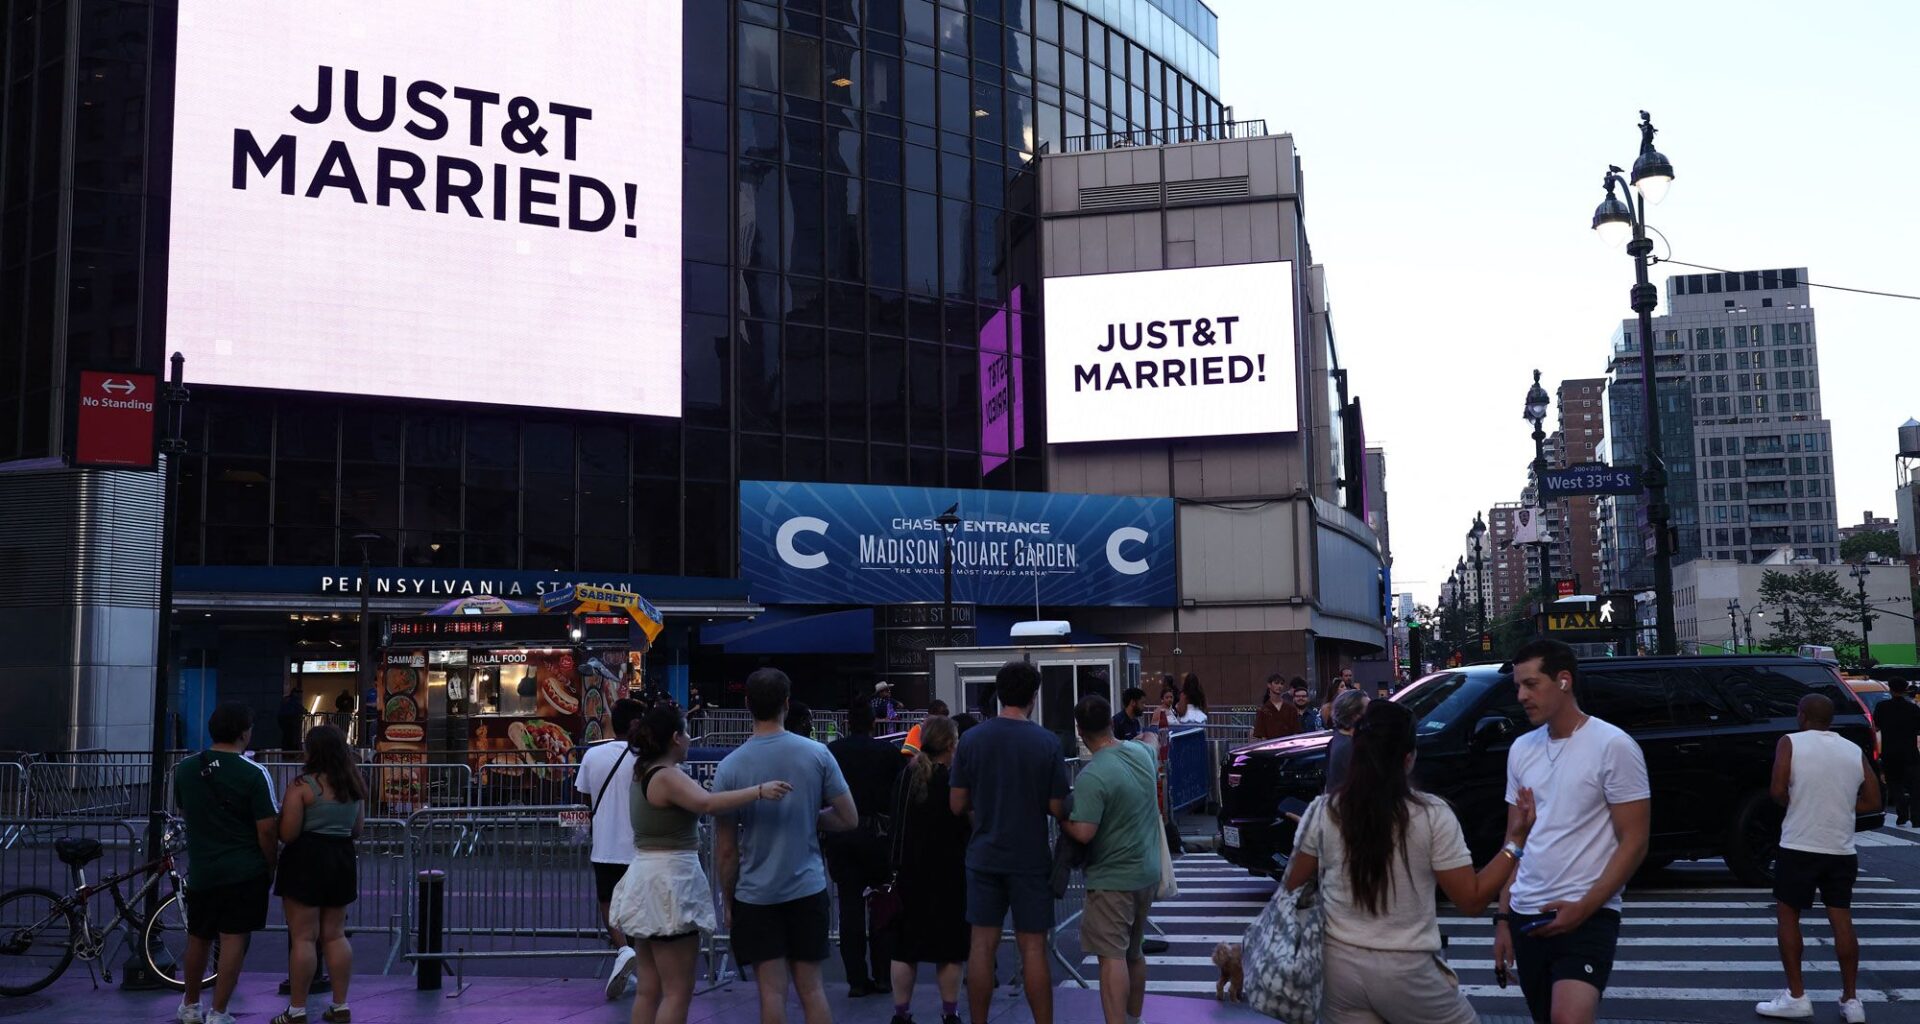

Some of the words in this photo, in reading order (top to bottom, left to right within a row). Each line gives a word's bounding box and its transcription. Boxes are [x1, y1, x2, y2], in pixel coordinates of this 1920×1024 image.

[290, 65, 592, 161] JUST&T
[232, 128, 638, 238] MARRIED!
[1097, 315, 1239, 352] JUST&T
[1074, 353, 1266, 392] MARRIED!
[82, 396, 99, 407] No
[101, 397, 153, 412] Standing
[1547, 476, 1583, 489] West
[1586, 473, 1612, 488] 33rd
[1616, 473, 1631, 487] St
[892, 518, 943, 530] CHASE
[964, 520, 1050, 534] ENTRANCE
[775, 516, 829, 569] C
[860, 534, 939, 565] MADISON
[1014, 539, 1076, 567] GARDEN
[1105, 526, 1150, 575] C
[322, 577, 523, 595] PENNSYLVANIA
[580, 588, 635, 605] SABRETT
[930, 607, 971, 622] STTION
[387, 655, 425, 664] SAMMY'S
[472, 655, 500, 663] HALAL
[502, 654, 527, 663] FOOD
